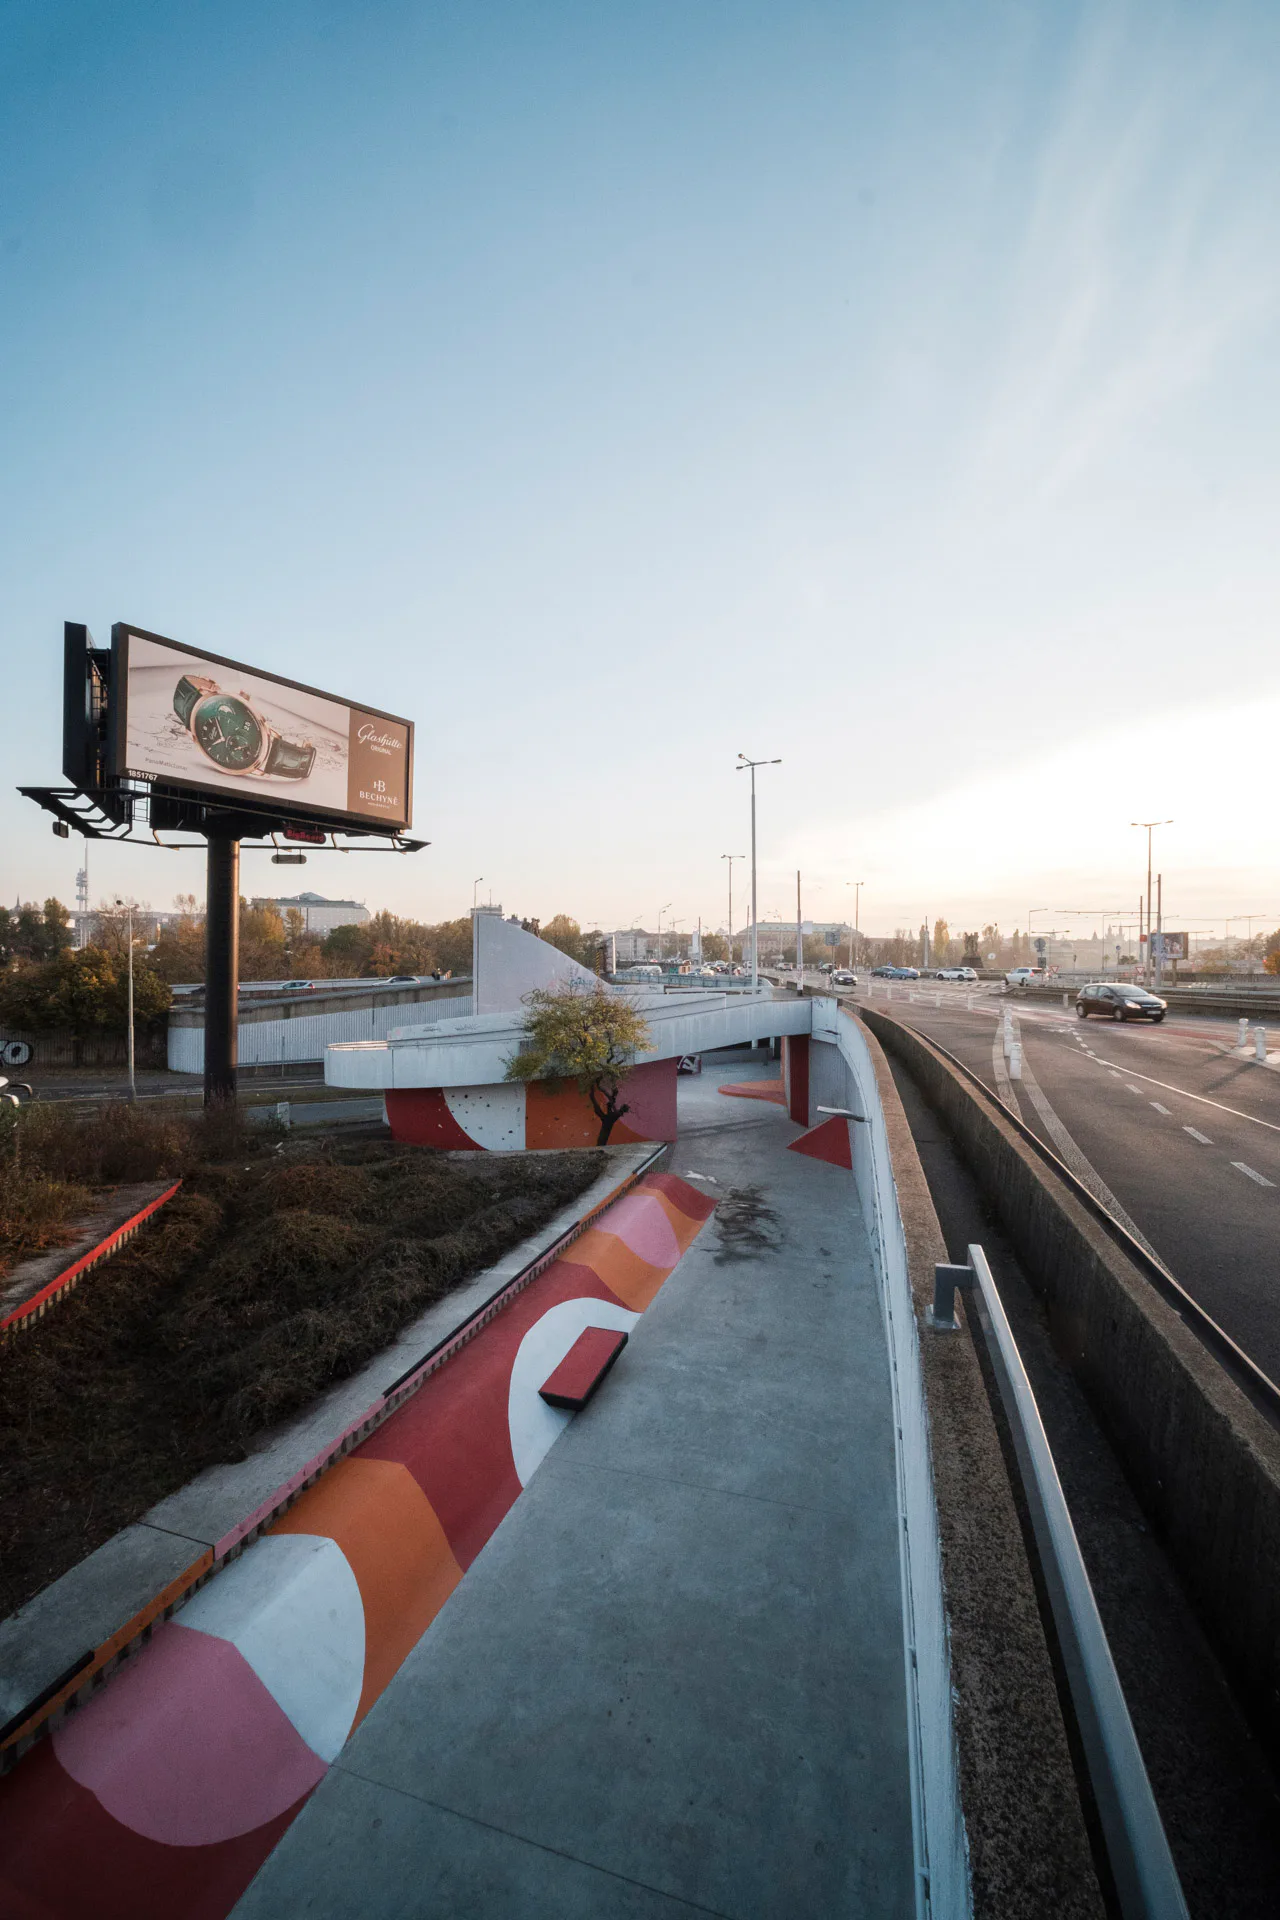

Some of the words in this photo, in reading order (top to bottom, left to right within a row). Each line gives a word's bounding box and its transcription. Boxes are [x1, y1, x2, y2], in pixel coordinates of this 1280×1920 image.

[358, 723, 402, 749] Glashütte
[370, 744, 392, 756] ORIGINAL
[128, 770, 158, 781] 1851767
